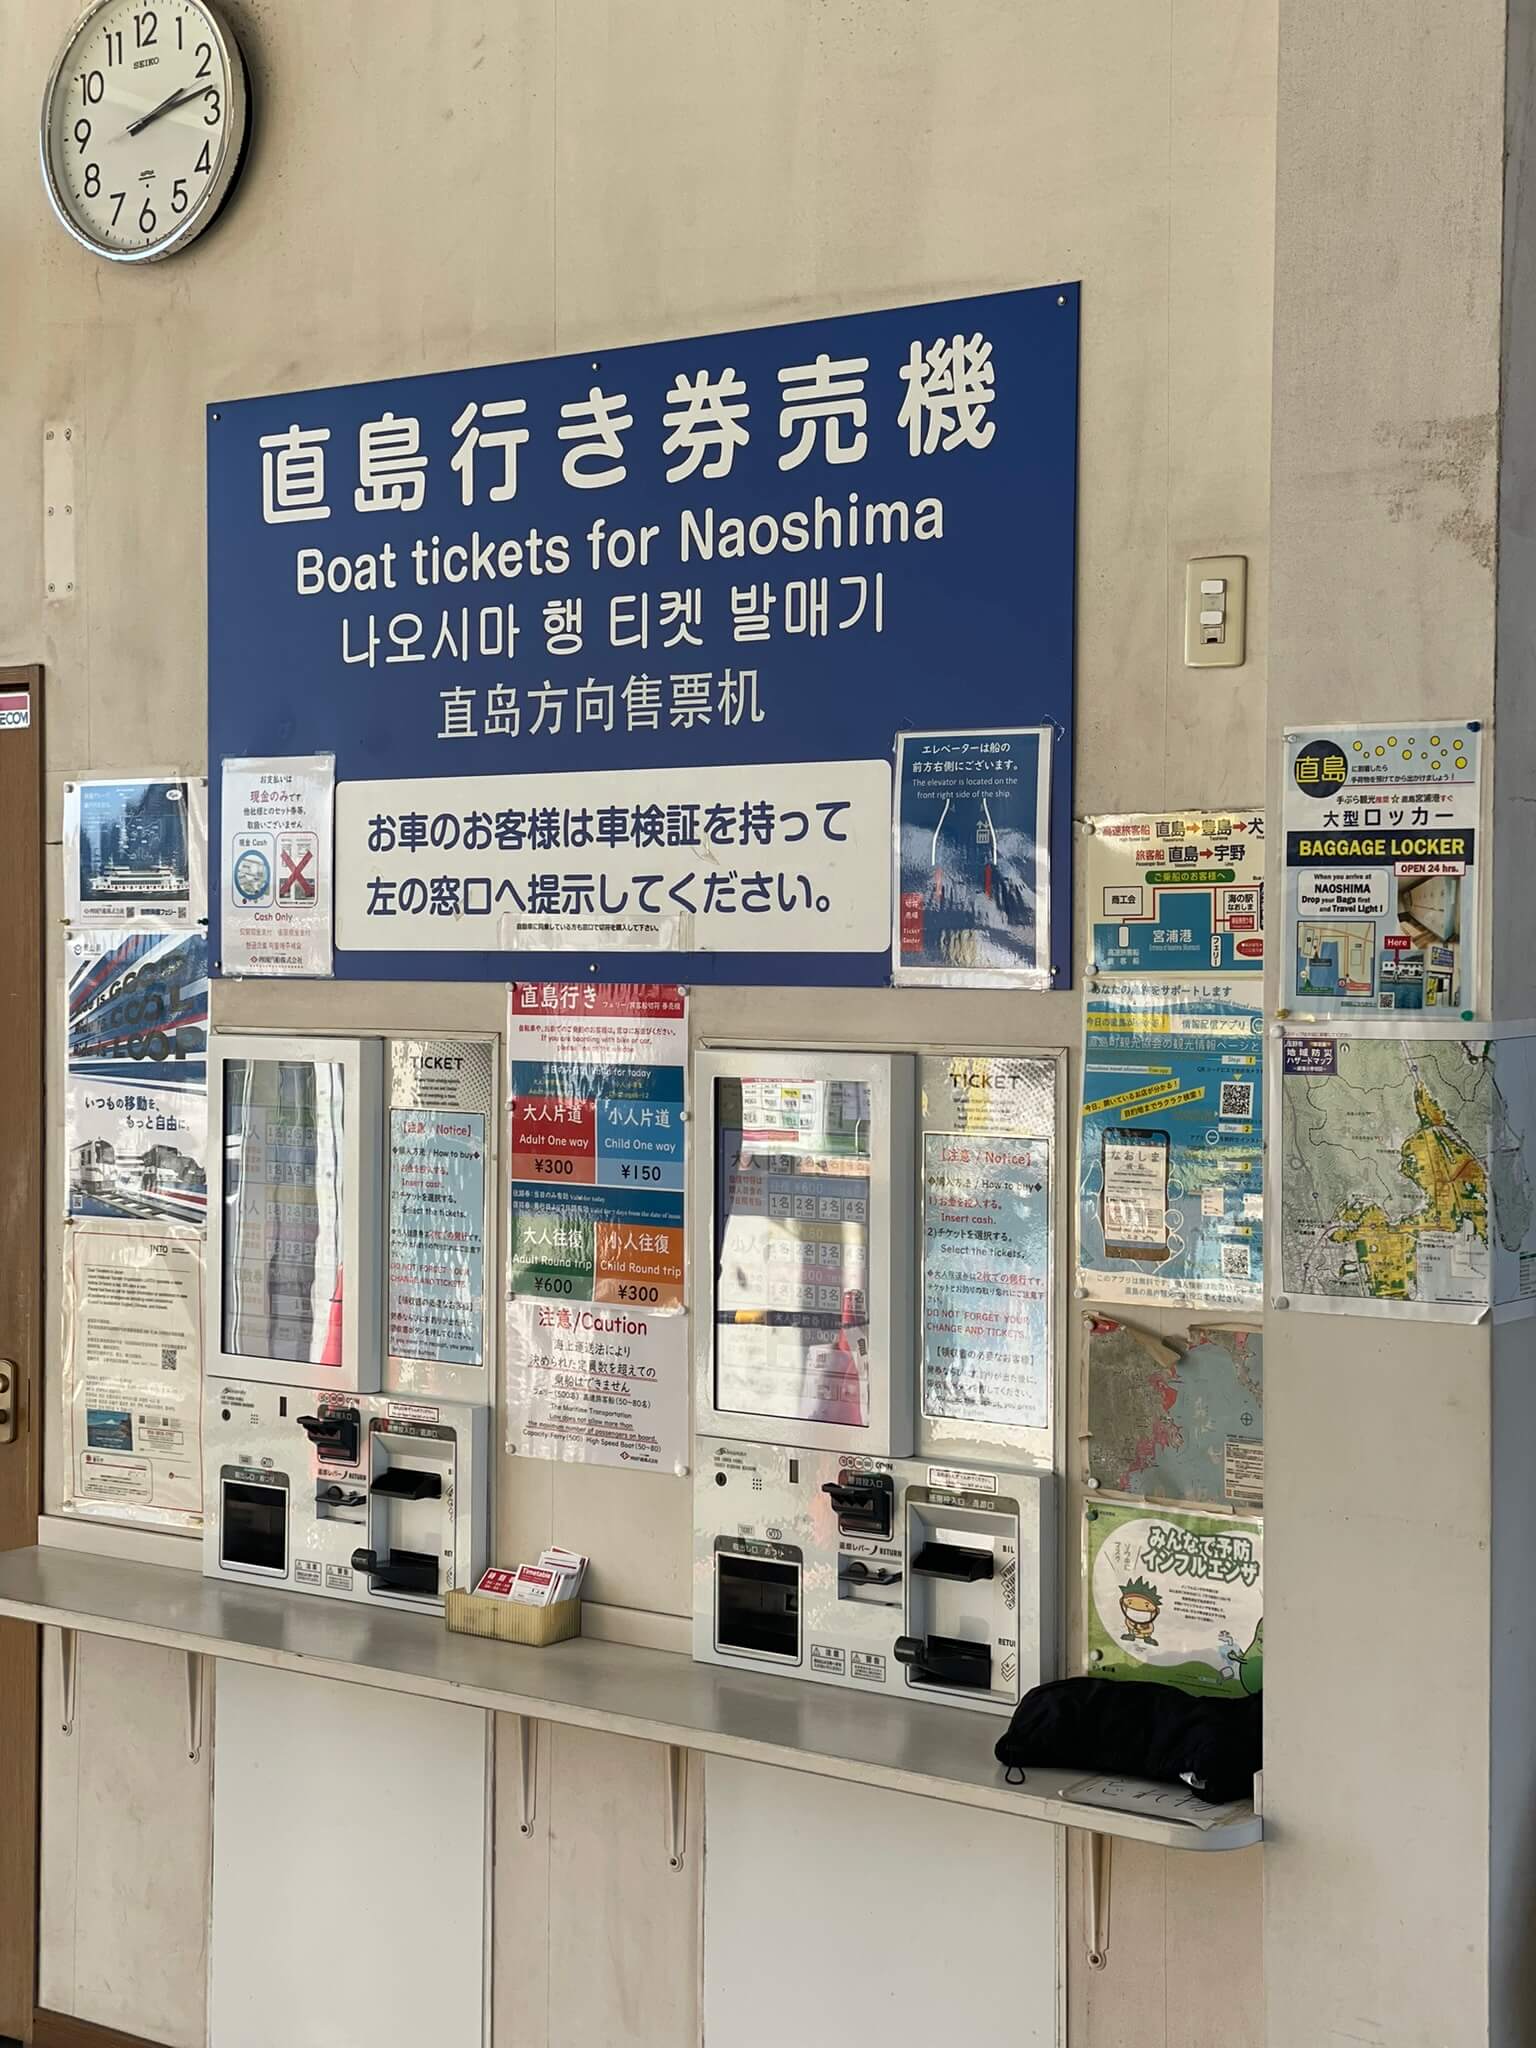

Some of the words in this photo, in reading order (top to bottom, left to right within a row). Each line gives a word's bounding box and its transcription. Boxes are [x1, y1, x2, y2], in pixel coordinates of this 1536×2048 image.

[133, 11, 158, 48] 12
[175, 16, 183, 50] 1
[105, 31, 123, 67] 11
[133, 56, 160, 70] SEIKO
[194, 42, 211, 78] 2
[79, 70, 104, 106] 10
[204, 89, 220, 126] 3
[74, 118, 91, 154] 9
[194, 140, 211, 174] 4
[84, 163, 101, 198] 8
[171, 179, 188, 213] 5
[110, 192, 126, 226] 7
[139, 197, 156, 233] 6
[259, 331, 996, 525] 直島行き券売機
[296, 543, 397, 595] Boat
[411, 528, 571, 585] tickets
[586, 518, 661, 570] for
[681, 493, 944, 562] Naoshima
[341, 603, 520, 669] 나오시마
[542, 596, 585, 656] 행
[607, 588, 704, 650] 티켓
[730, 572, 884, 645] 발매기
[437, 668, 766, 740] 直岛方向售票机
[921, 742, 1011, 754] エレベーターは船の
[912, 759, 1018, 773] 前方右側にございます。
[1296, 755, 1346, 783] 直島
[912, 779, 926, 787] The
[927, 779, 956, 787] elevator
[966, 777, 993, 785] located
[1005, 776, 1018, 784] the
[917, 791, 935, 799] front
[937, 791, 954, 800] right
[956, 790, 970, 798] side
[972, 790, 980, 798] of
[981, 790, 994, 798] the
[1323, 806, 1454, 828] 大型ロッカー
[367, 800, 852, 853] お車のお客様は車検証を持って
[1155, 821, 1185, 838] 直島
[1136, 849, 1165, 861] 旅客船
[1168, 846, 1198, 862] 直島
[1214, 844, 1246, 861] 宇野
[1299, 839, 1386, 856] BAGGAGE
[1391, 838, 1464, 855] LOCKER
[1154, 871, 1226, 882] ご乗船のお客様へ
[1401, 864, 1425, 873] OPEN
[1427, 864, 1440, 873] 24
[1442, 864, 1459, 873] hrs.
[366, 870, 831, 917] 左の窓口へ提示してください。
[1314, 884, 1371, 893] NAOSHIMA
[1111, 895, 1136, 905] 商工会
[1227, 903, 1253, 911] なおしま
[1302, 896, 1320, 904] Drop
[254, 912, 273, 921] Cash
[275, 912, 293, 922] Only
[1332, 905, 1356, 913] Travel
[1153, 929, 1192, 943] 宮浦港
[521, 985, 597, 1010] 直島行き
[410, 1056, 464, 1070] TICKET
[1287, 1057, 1333, 1065] ハザードマップ
[628, 1070, 651, 1079] today
[950, 1073, 1020, 1089] TICKET
[85, 1096, 160, 1112] いつもの移動を、
[523, 1103, 583, 1124] 大人片道
[608, 1107, 672, 1128] 小人片道
[126, 1115, 190, 1131] もっと自由に。
[519, 1134, 546, 1145] Adult
[548, 1135, 567, 1147] One
[569, 1138, 589, 1149] way
[604, 1138, 630, 1149] Child
[633, 1139, 653, 1150] One
[655, 1142, 676, 1153] way
[433, 1149, 449, 1158] How
[451, 1151, 458, 1159] to
[1112, 1150, 1160, 1162] なおしま
[534, 1159, 573, 1174] ¥300
[621, 1164, 661, 1181] ¥150
[981, 1180, 1001, 1190] How
[1004, 1181, 1014, 1190] to
[941, 1213, 969, 1224] Insert
[971, 1215, 996, 1225] cash.
[523, 1227, 583, 1249] 大人往復
[607, 1231, 670, 1254] 小人往復
[927, 1228, 1012, 1243] 2)チケットを選択する。
[940, 1244, 969, 1255] Select
[971, 1246, 987, 1257] the
[990, 1247, 1026, 1259] tickets.
[513, 1253, 539, 1265] Adult
[541, 1255, 571, 1268] Round
[573, 1257, 592, 1271] trip
[600, 1260, 626, 1272] Child
[628, 1261, 660, 1275] Round
[663, 1264, 682, 1280] trip
[534, 1277, 573, 1294] ¥600
[618, 1285, 659, 1302] ¥300
[538, 1306, 648, 1336] 注意/Caution
[926, 1308, 939, 1317] DO
[942, 1309, 960, 1319] NOT
[964, 1311, 1000, 1323] FORGET
[926, 1322, 962, 1333] CHANGE
[965, 1325, 984, 1335] AND
[589, 1407, 632, 1419] Transportation
[601, 1438, 619, 1447] Speed
[1149, 1525, 1253, 1562] みんなで予防
[879, 1547, 902, 1558] RETURN
[1141, 1551, 1260, 1587] インフルエンザ
